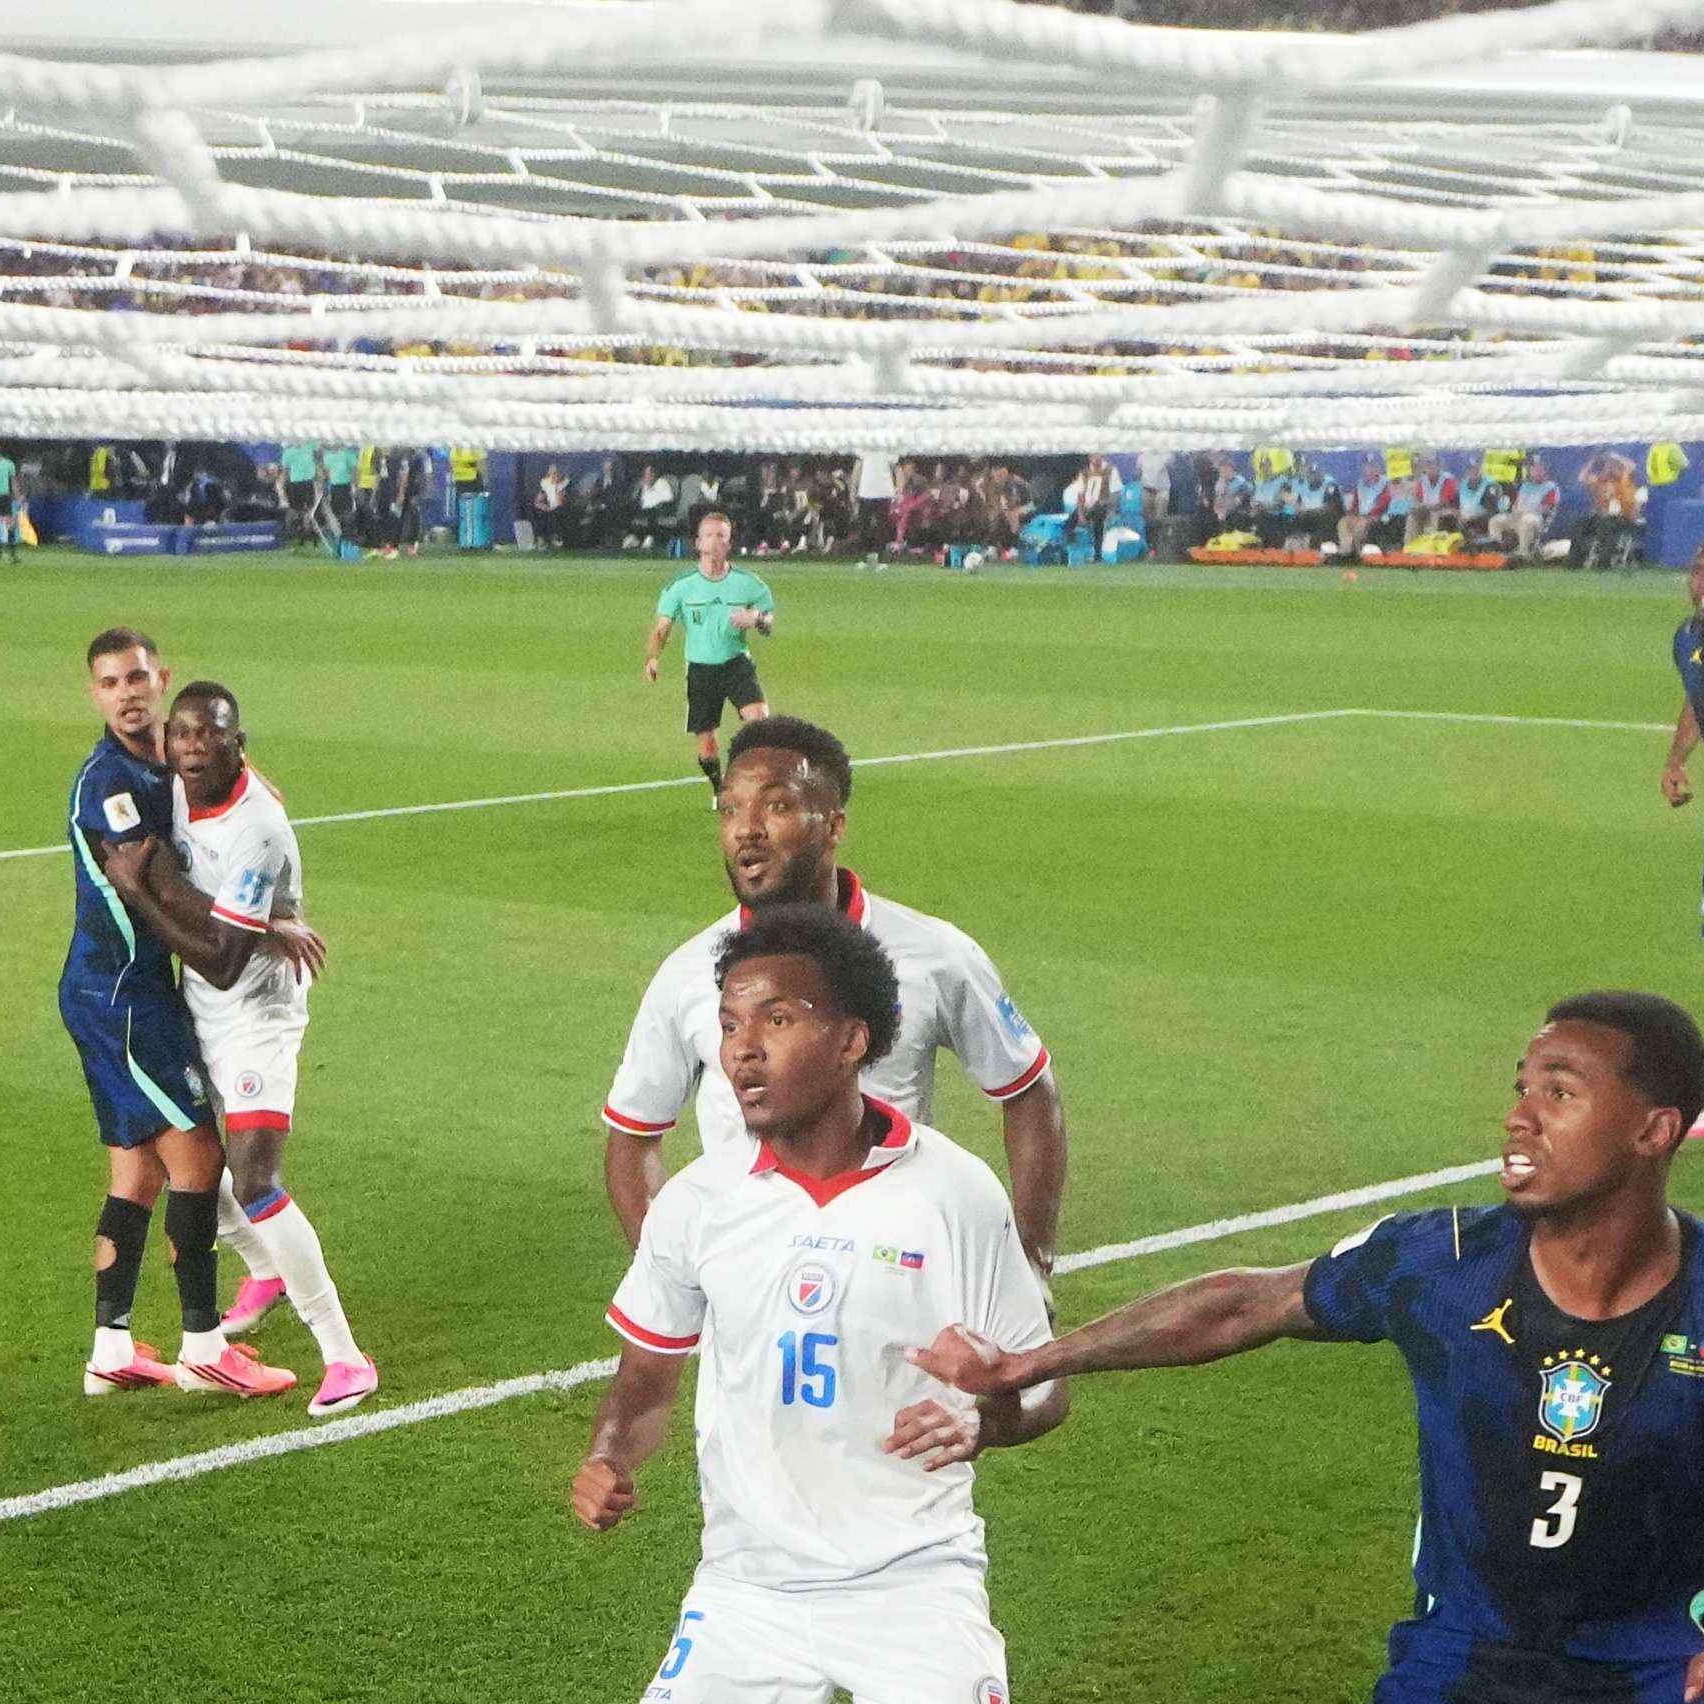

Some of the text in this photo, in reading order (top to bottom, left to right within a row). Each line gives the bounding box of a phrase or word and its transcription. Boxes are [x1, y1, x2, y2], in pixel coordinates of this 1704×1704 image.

[787, 1233, 857, 1253] SAETA
[776, 1329, 839, 1409] 15
[1532, 1434, 1598, 1458] BRASIL
[1529, 1470, 1583, 1549] 3
[660, 1610, 706, 1680] 5
[645, 1686, 673, 1701] ETA
